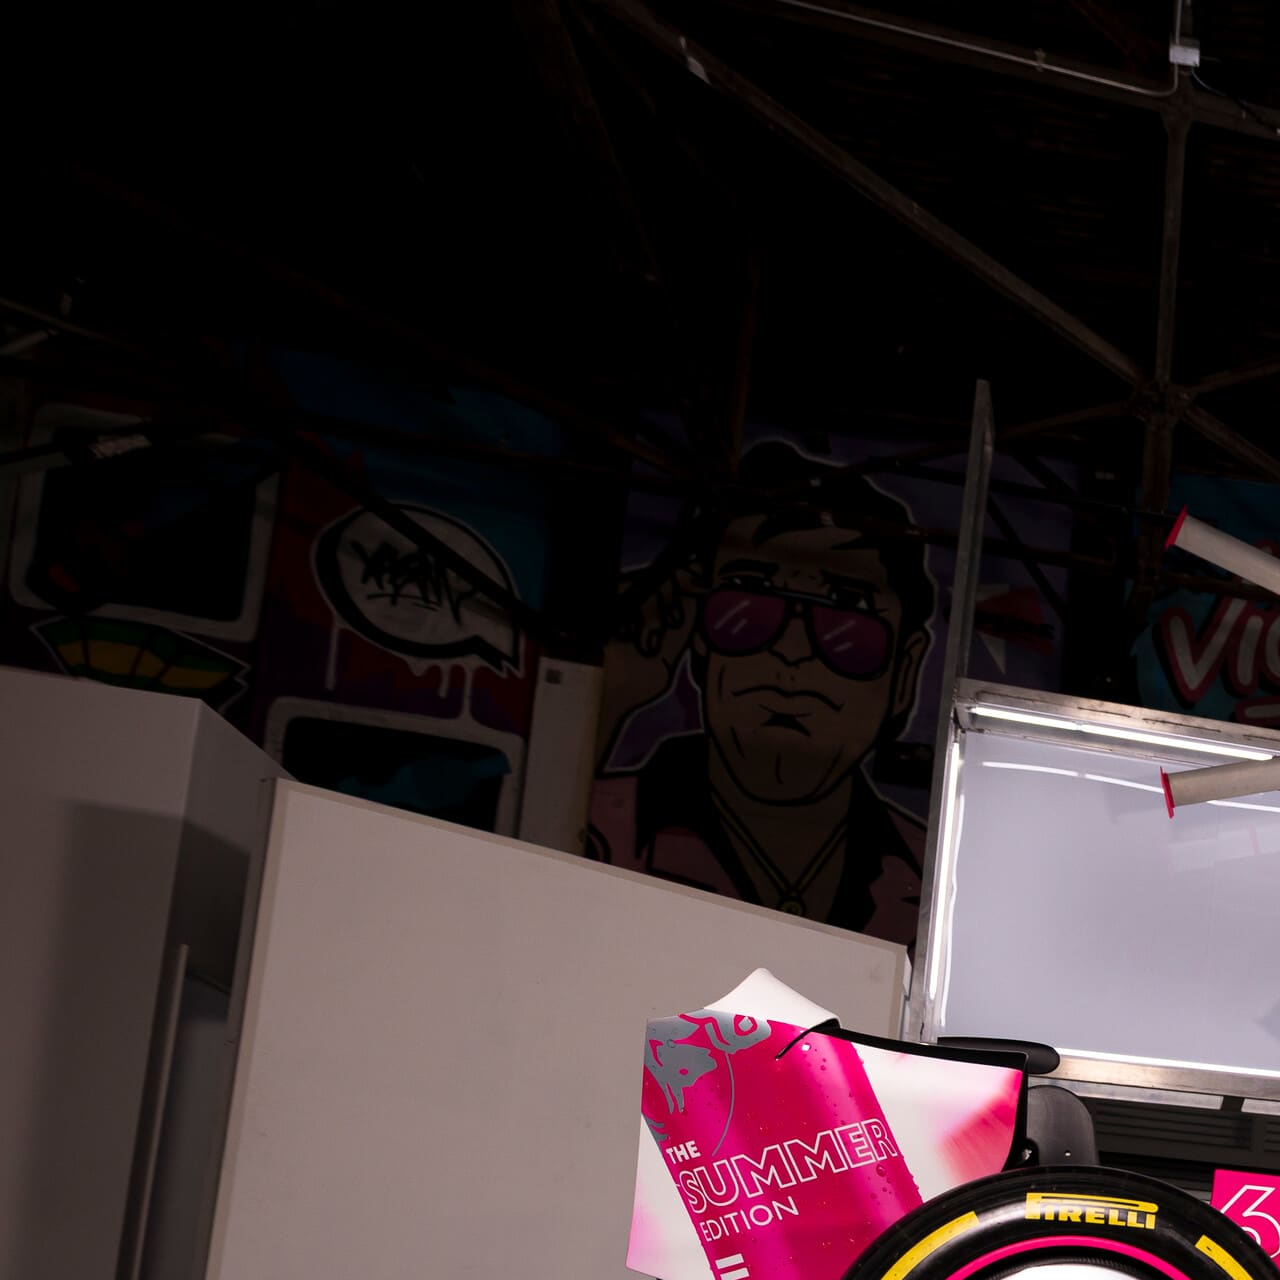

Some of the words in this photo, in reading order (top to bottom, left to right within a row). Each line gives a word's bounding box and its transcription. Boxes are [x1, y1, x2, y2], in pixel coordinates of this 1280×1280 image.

[666, 1140, 701, 1164] THE
[679, 1118, 898, 1214] SUMMER
[700, 1195, 799, 1242] EDITION
[1024, 1192, 1159, 1230] PIRELLI
